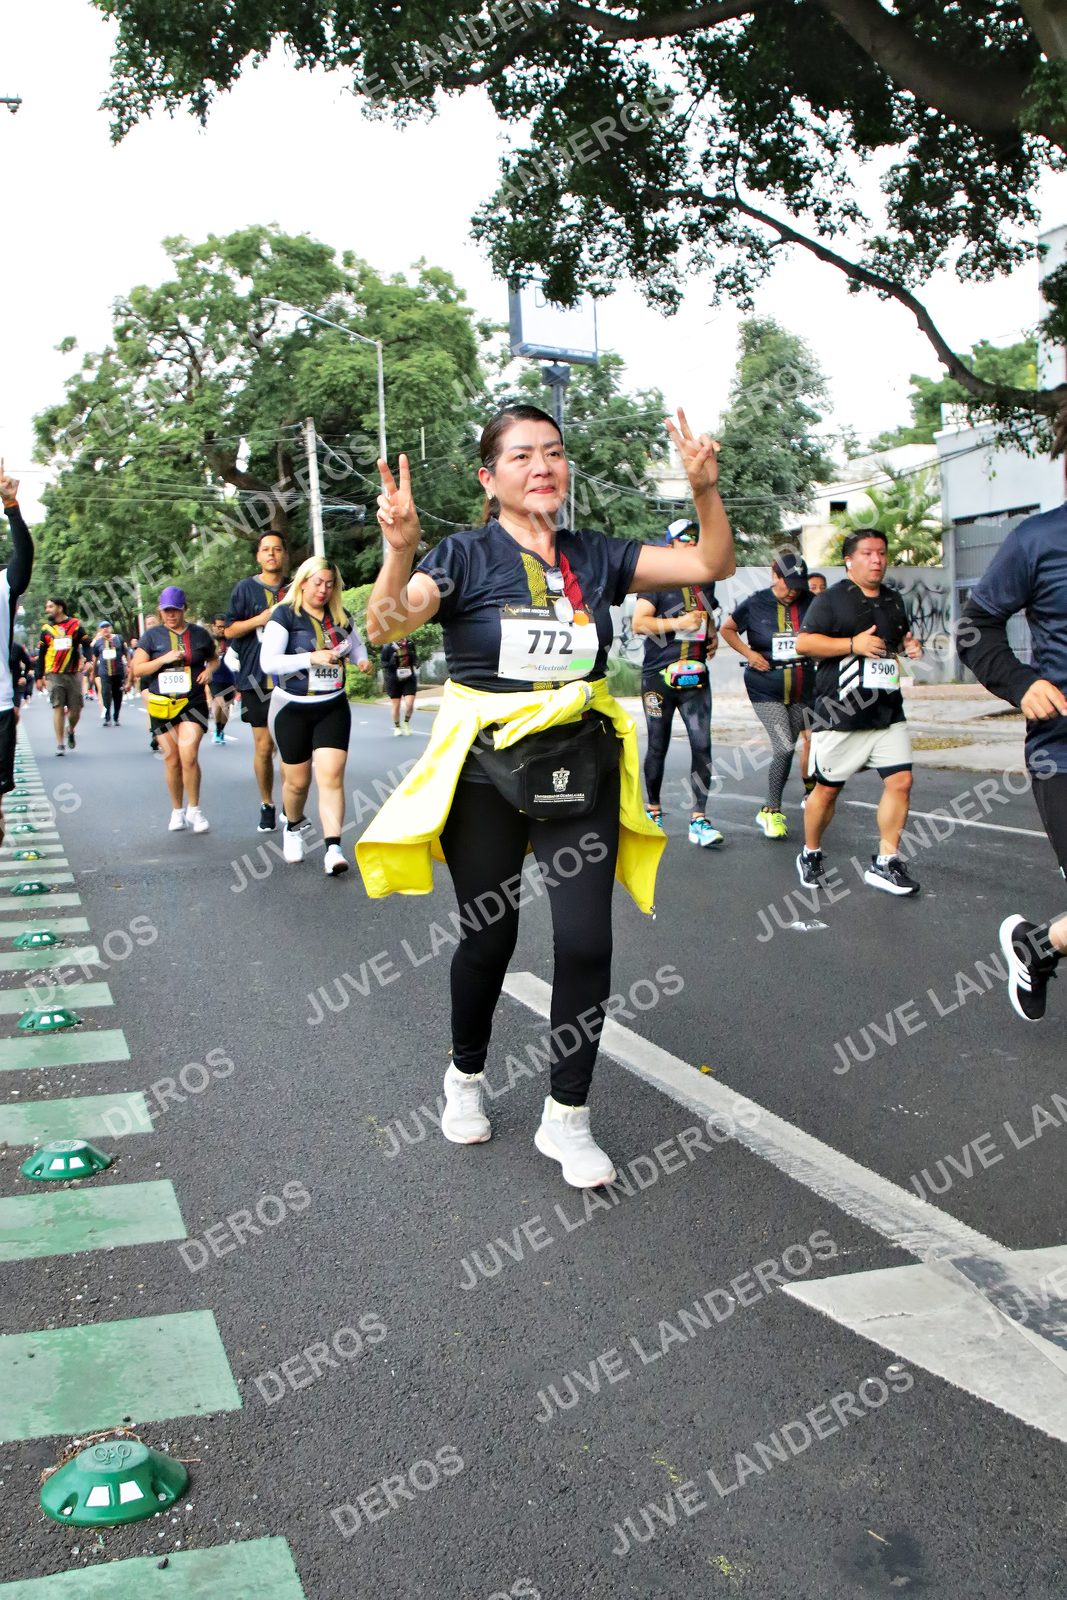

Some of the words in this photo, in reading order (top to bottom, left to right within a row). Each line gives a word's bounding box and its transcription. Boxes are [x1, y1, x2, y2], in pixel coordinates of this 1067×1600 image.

[528, 630, 573, 655] 772
[778, 640, 794, 650] 212
[315, 668, 338, 679] 4448
[871, 662, 895, 675] 5900
[163, 675, 184, 685] 2508
